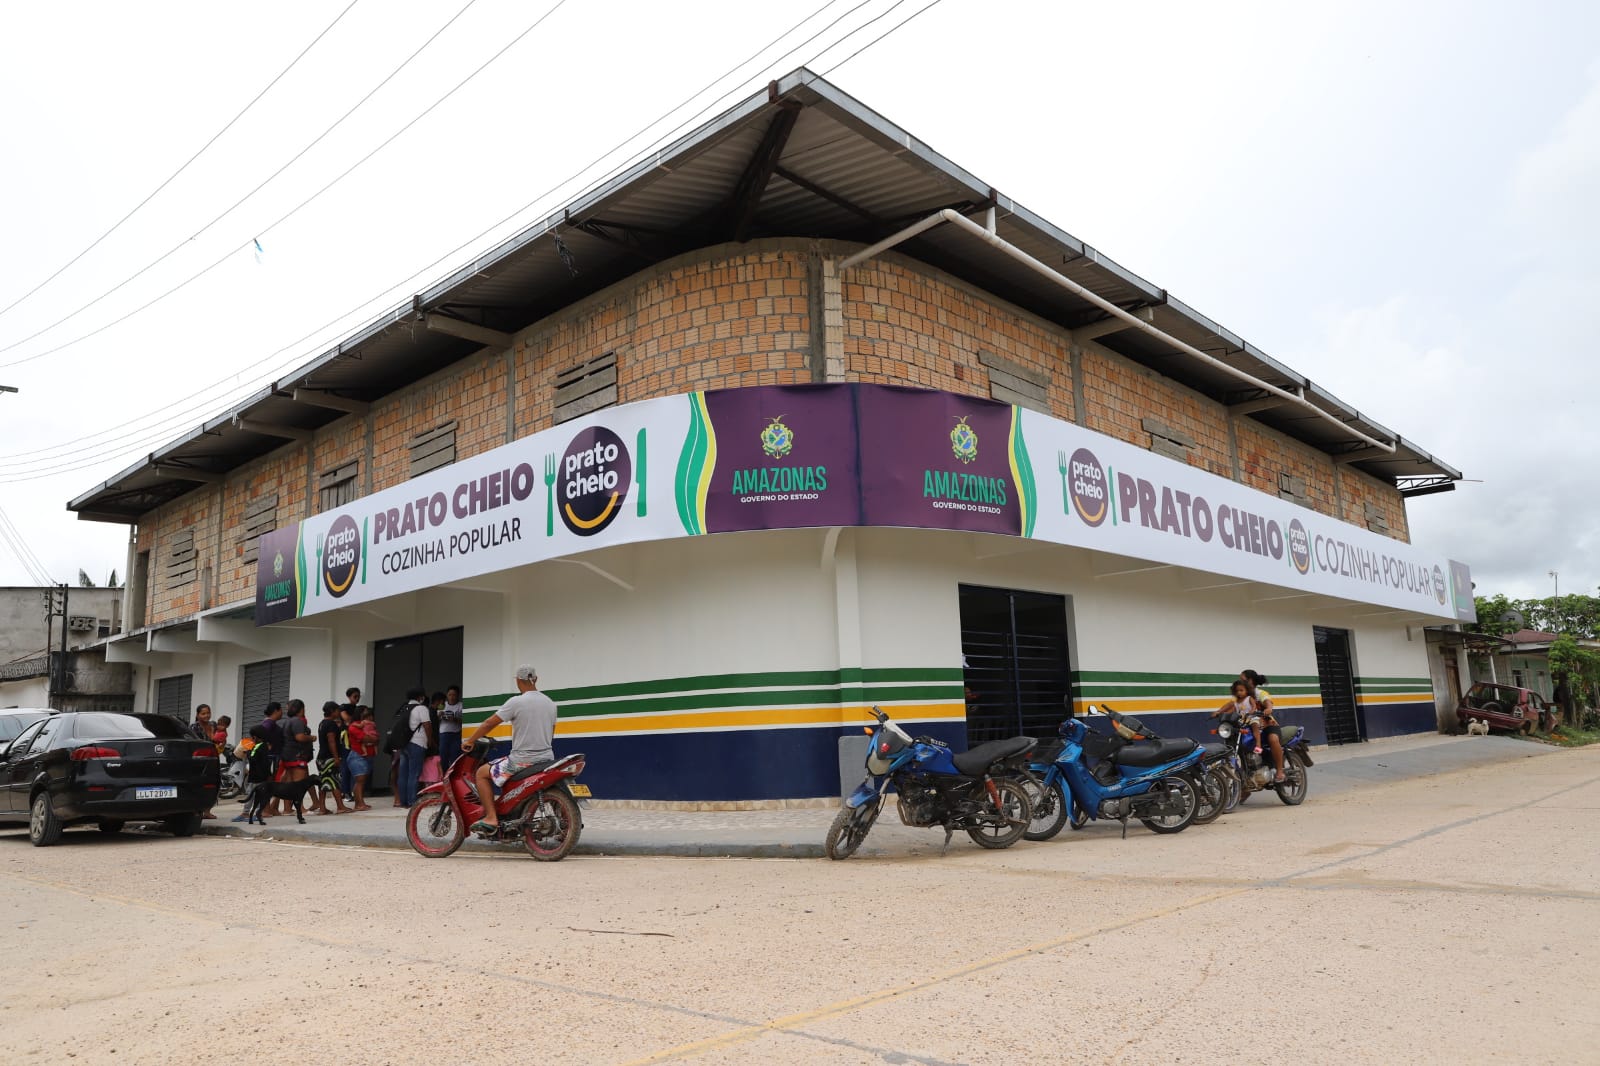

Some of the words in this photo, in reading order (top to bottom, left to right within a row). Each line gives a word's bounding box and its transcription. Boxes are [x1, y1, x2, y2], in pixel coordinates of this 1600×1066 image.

[565, 441, 619, 480] prato
[1072, 460, 1102, 480] prato
[566, 465, 619, 499] cheio
[732, 465, 828, 495] AMAZONAS
[923, 469, 1007, 506] AMAZONAS
[1074, 477, 1103, 500] cheio
[373, 491, 448, 545] PRATO
[452, 462, 535, 519] CHEIO
[740, 494, 776, 503] GOVERNO
[932, 501, 966, 510] GOVERNO
[978, 505, 1001, 514] ESTADO
[1117, 471, 1214, 543] PRATO
[1217, 503, 1284, 561] CHEIO
[328, 526, 356, 554] prato
[381, 538, 445, 575] COZINHA
[449, 517, 522, 558] POPULAR
[327, 545, 355, 568] cheio
[1314, 534, 1382, 585] COZINHA
[1382, 554, 1433, 597] POPULAR
